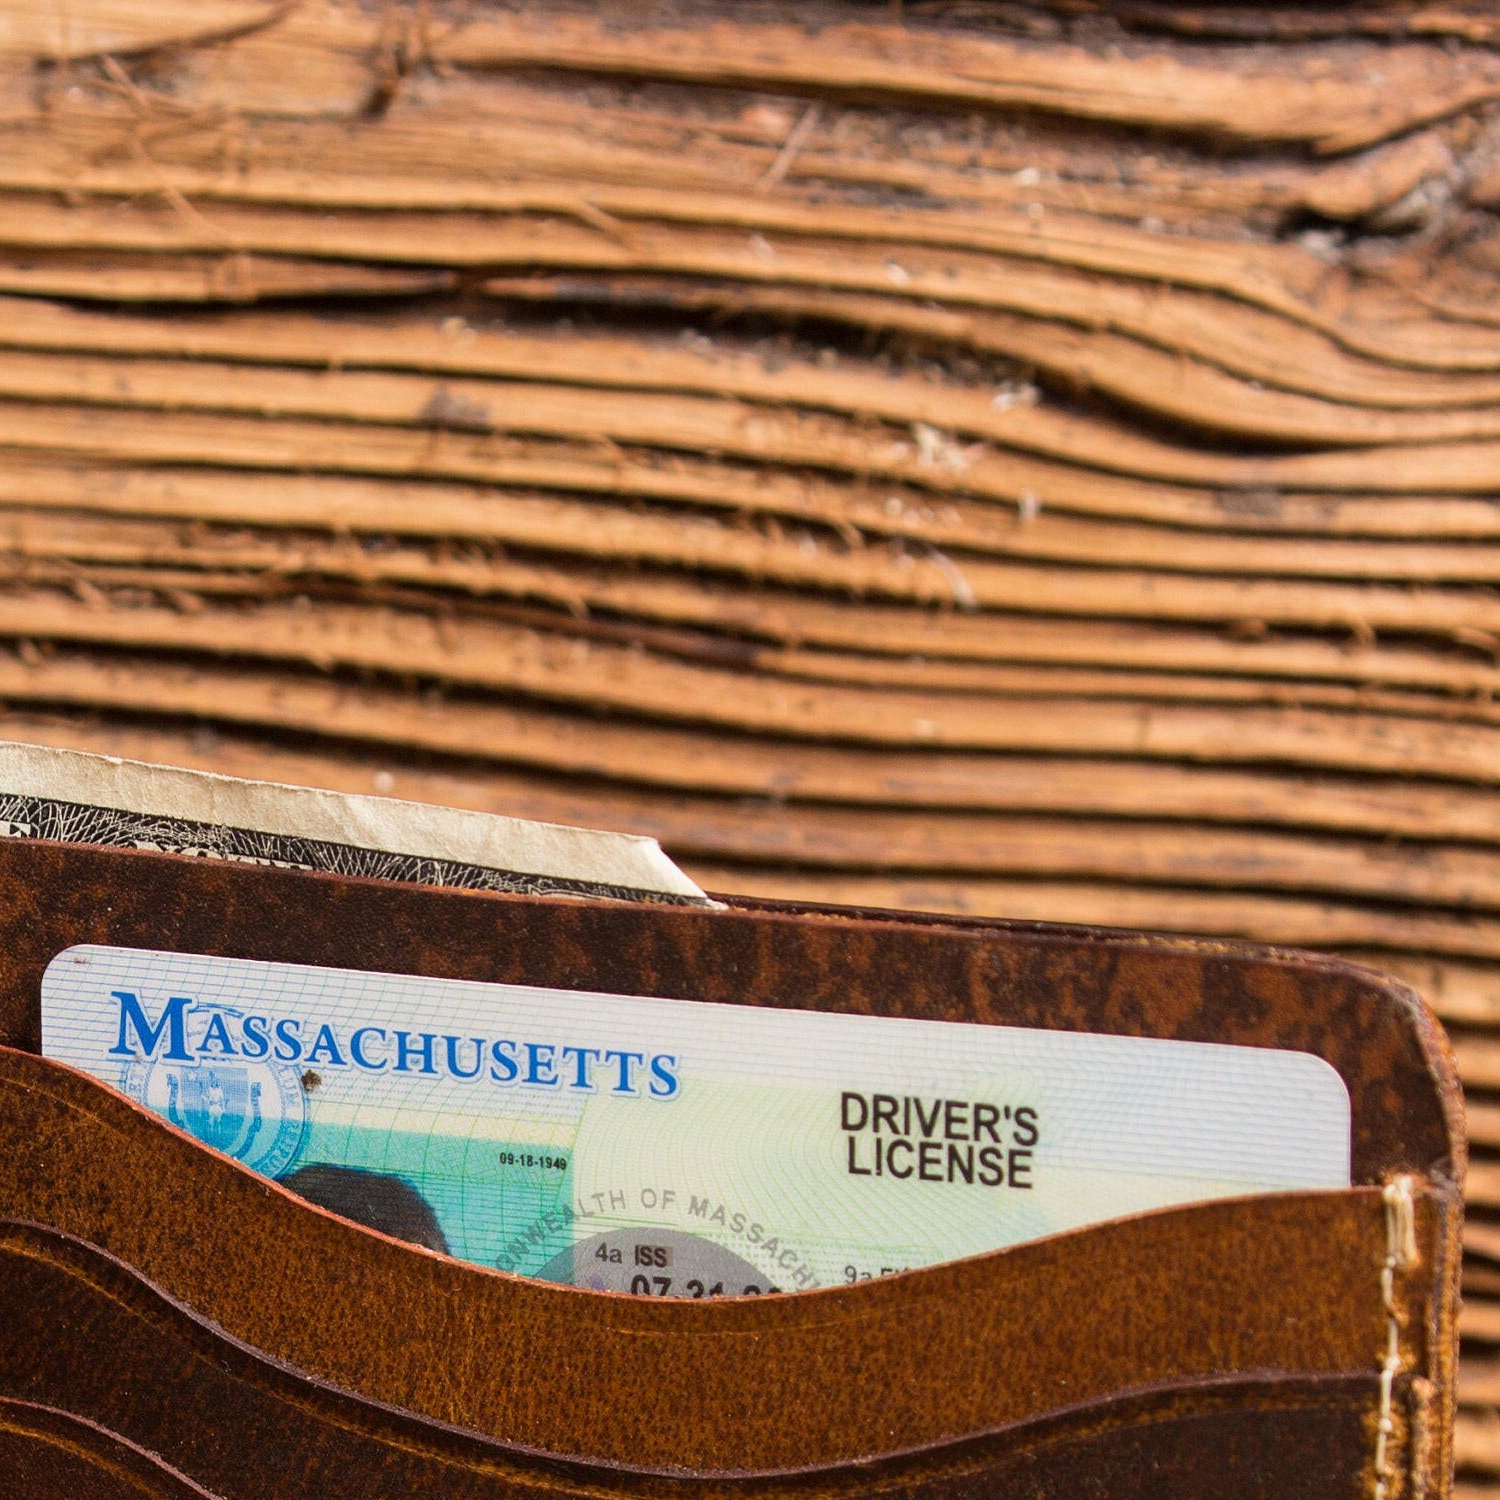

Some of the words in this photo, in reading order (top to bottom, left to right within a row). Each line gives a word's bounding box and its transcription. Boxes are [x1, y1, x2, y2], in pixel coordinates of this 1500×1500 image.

[108, 990, 679, 1098] MASSACHUSETTS
[839, 1091, 1040, 1148] DRIVER'S
[499, 1151, 568, 1171] 09-18-1949
[847, 1136, 1034, 1190] LICENSE
[594, 1241, 622, 1264] 4a
[634, 1244, 668, 1268] ISS
[640, 1187, 676, 1210] OF
[687, 1195, 821, 1289] MASSACH
